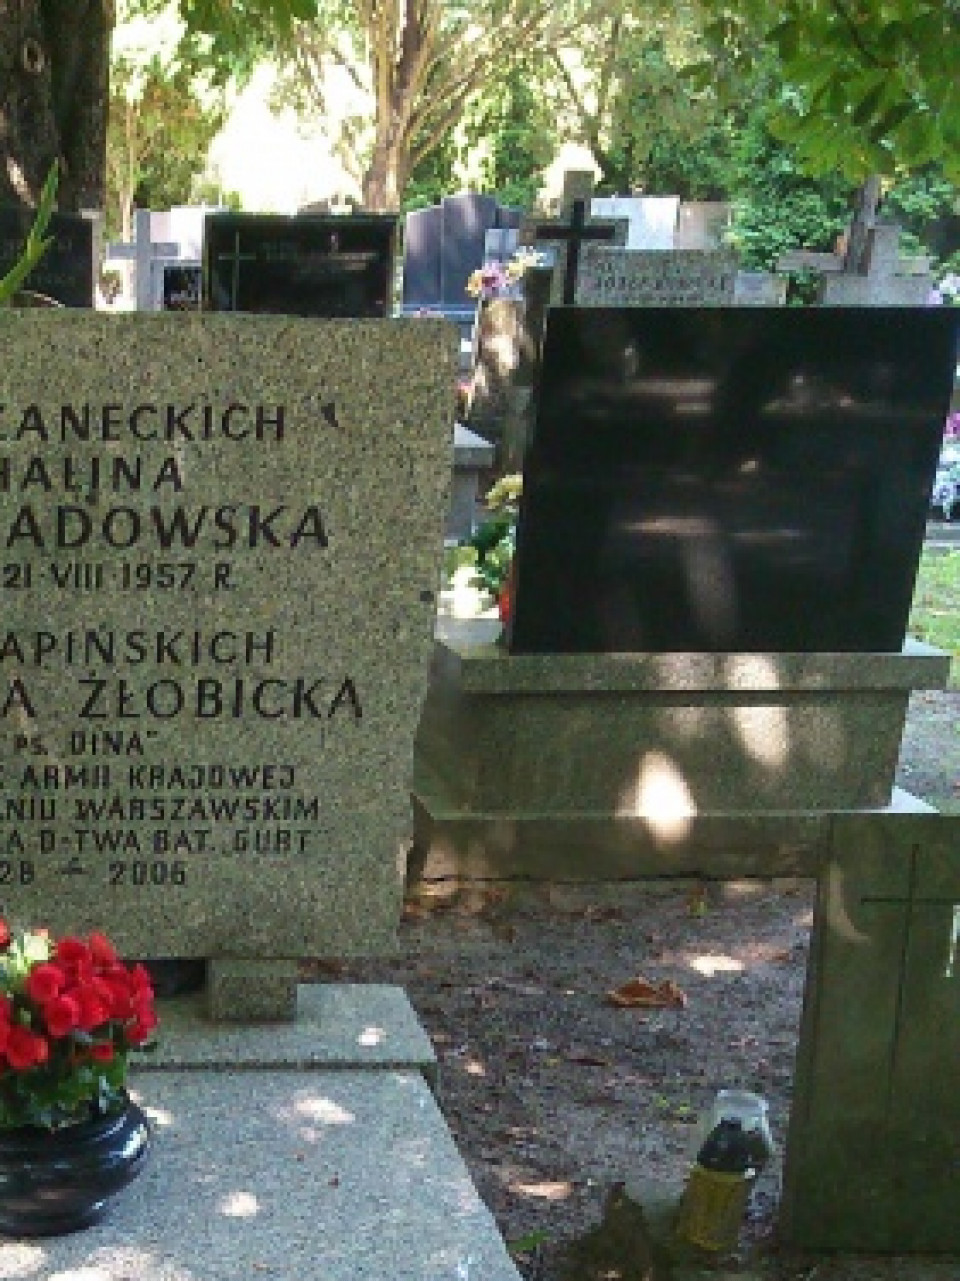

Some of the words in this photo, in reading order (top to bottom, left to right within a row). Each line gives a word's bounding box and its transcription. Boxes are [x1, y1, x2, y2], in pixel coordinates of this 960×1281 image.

[122, 563, 196, 589] 1957
[78, 668, 363, 719] ŻŁOBICKA
[128, 764, 295, 790] KRAJOWEJ
[74, 798, 319, 821] WARSZAWSKIM
[109, 860, 186, 886] 2006
